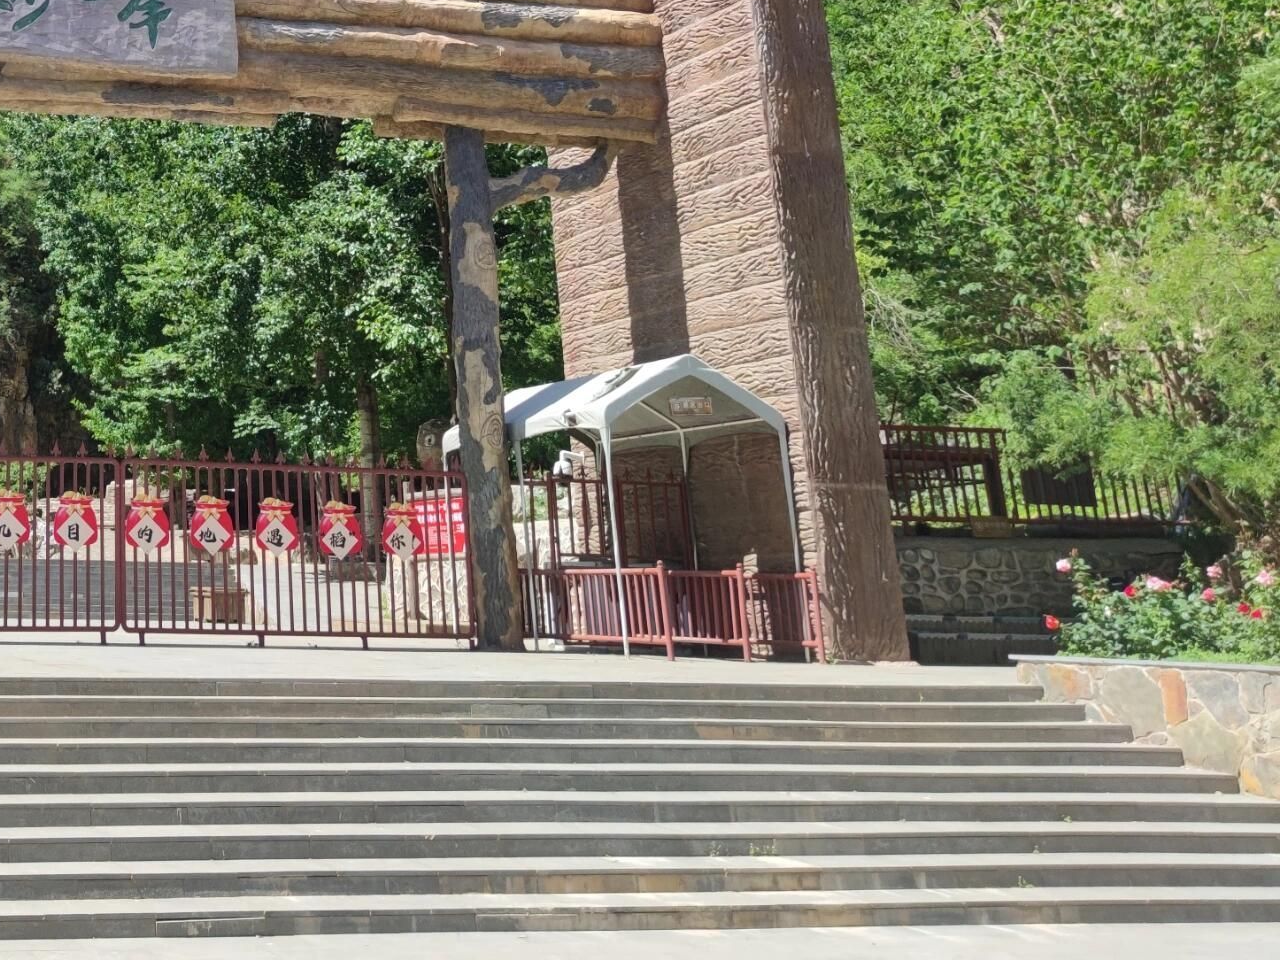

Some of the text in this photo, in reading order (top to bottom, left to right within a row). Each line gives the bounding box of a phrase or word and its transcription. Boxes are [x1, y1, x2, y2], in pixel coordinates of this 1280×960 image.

[67, 523, 80, 542] 目
[137, 525, 153, 543] 的
[266, 527, 284, 548] 遇
